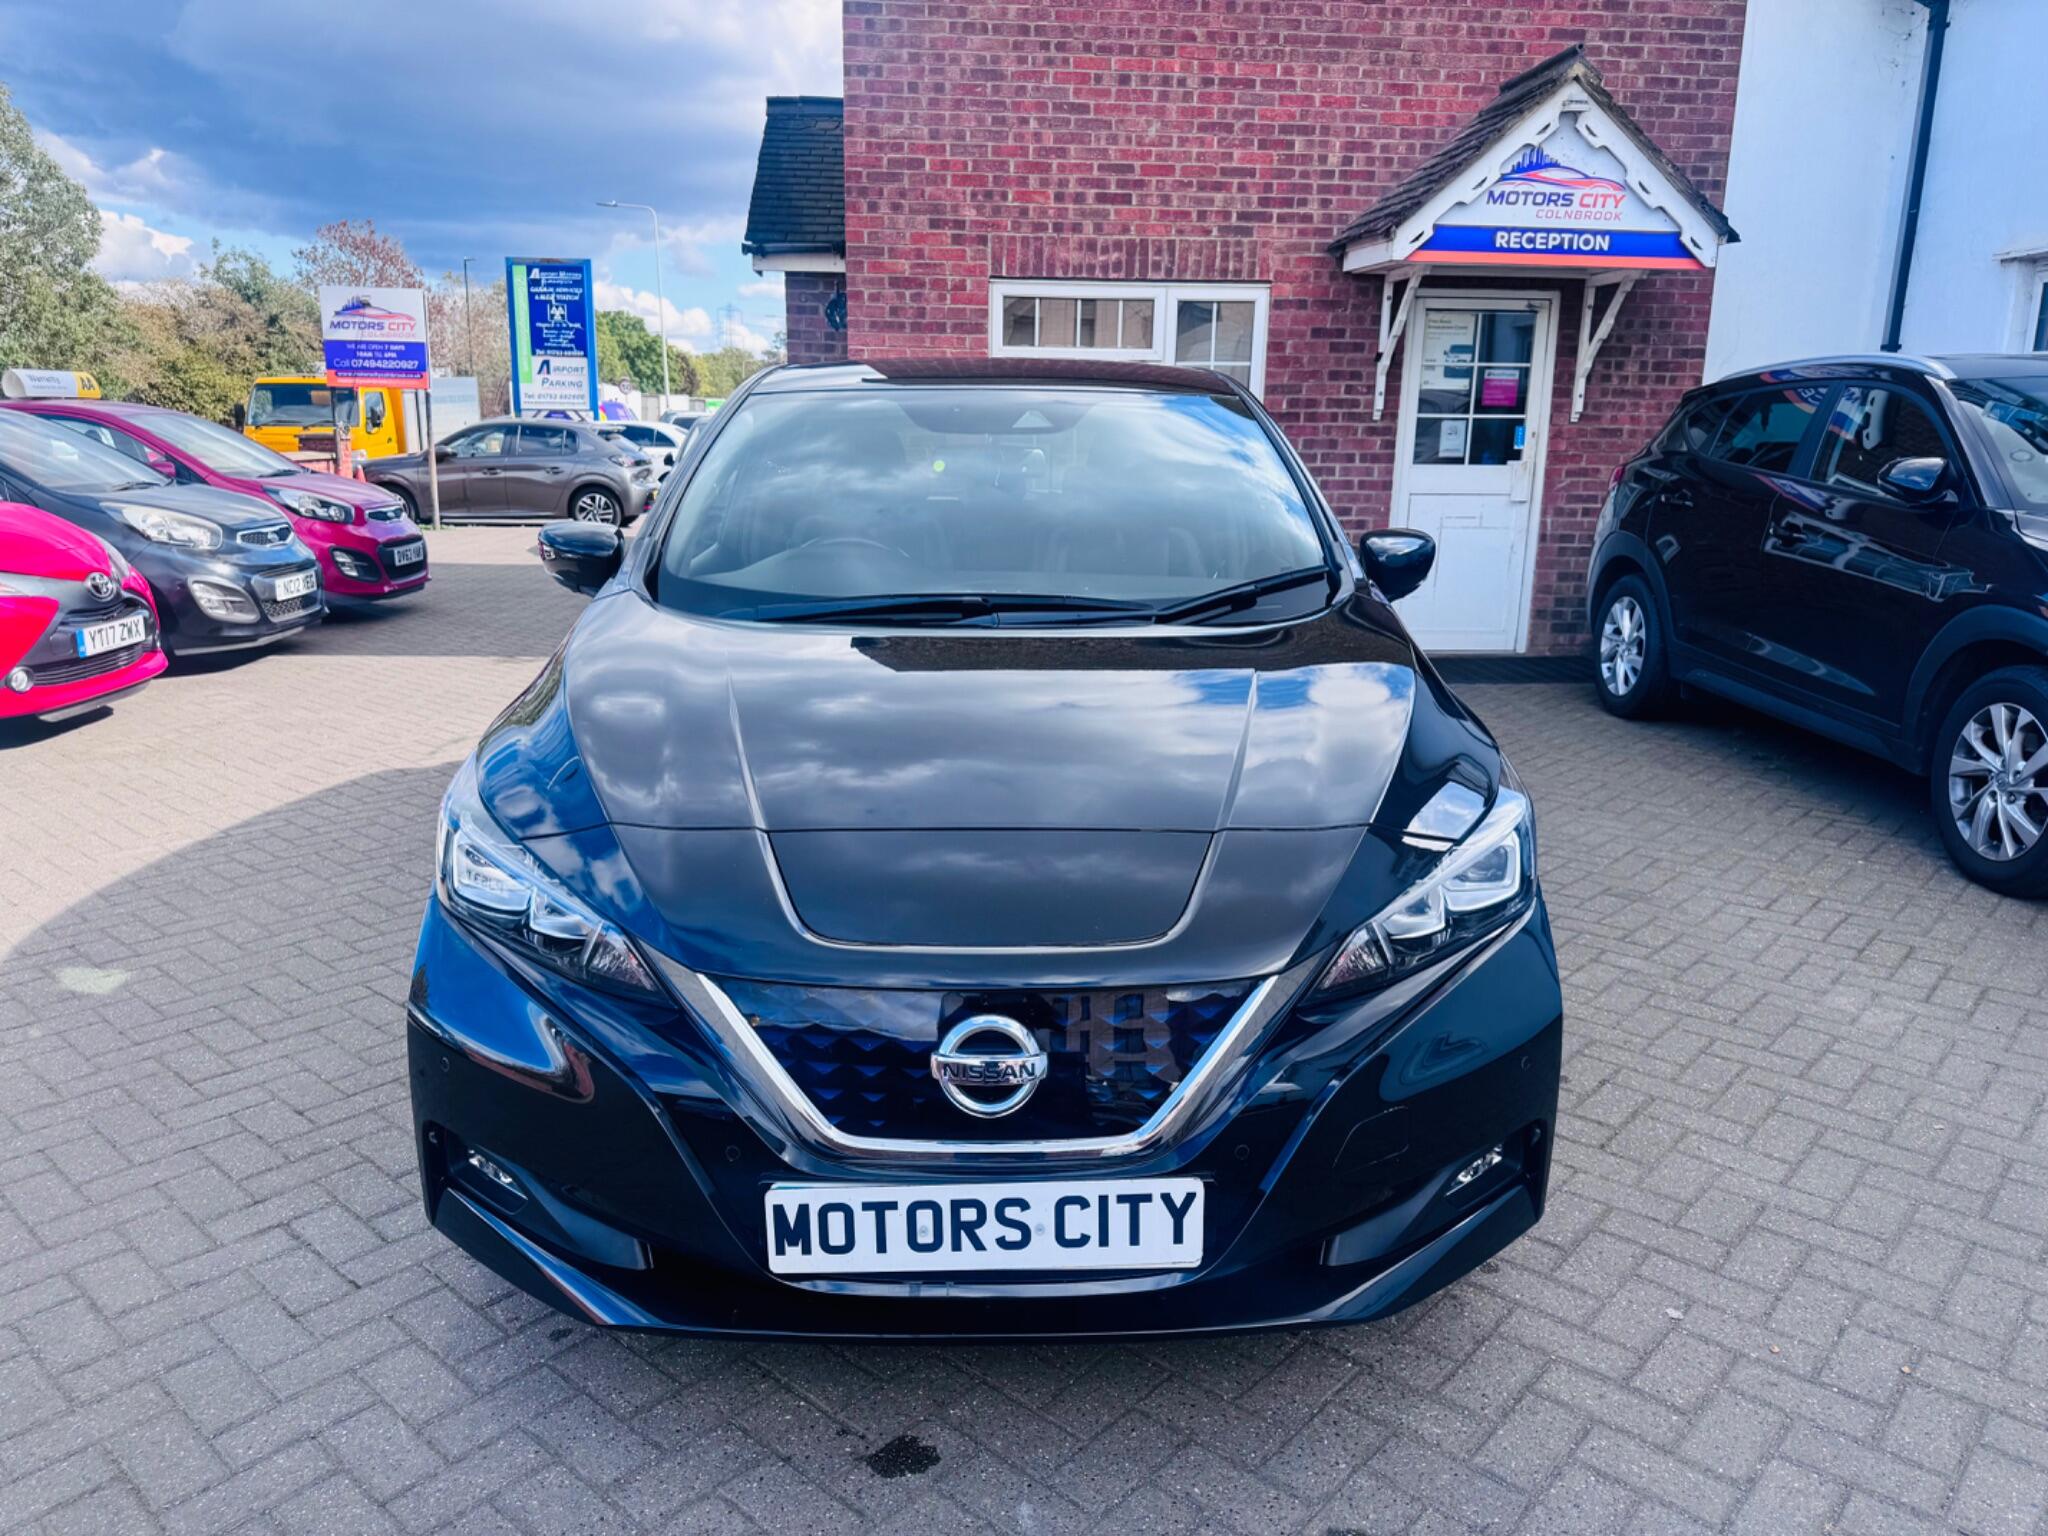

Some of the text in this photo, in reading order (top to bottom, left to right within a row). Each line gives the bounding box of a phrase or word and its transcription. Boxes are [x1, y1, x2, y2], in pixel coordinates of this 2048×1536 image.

[1486, 189, 1627, 209] MOTORS CITY
[1536, 209, 1623, 222] COLNBROOK
[1495, 230, 1610, 252] RECEPTION
[329, 320, 416, 331] MOTORS CITY
[333, 358, 350, 368] Call
[537, 359, 584, 375] AIRPORT
[541, 377, 584, 388] PARKING
[88, 618, 141, 648] YT17 ZWX
[942, 1062, 1036, 1079] NISSAN
[772, 1191, 1198, 1257] MOTORS CITY
